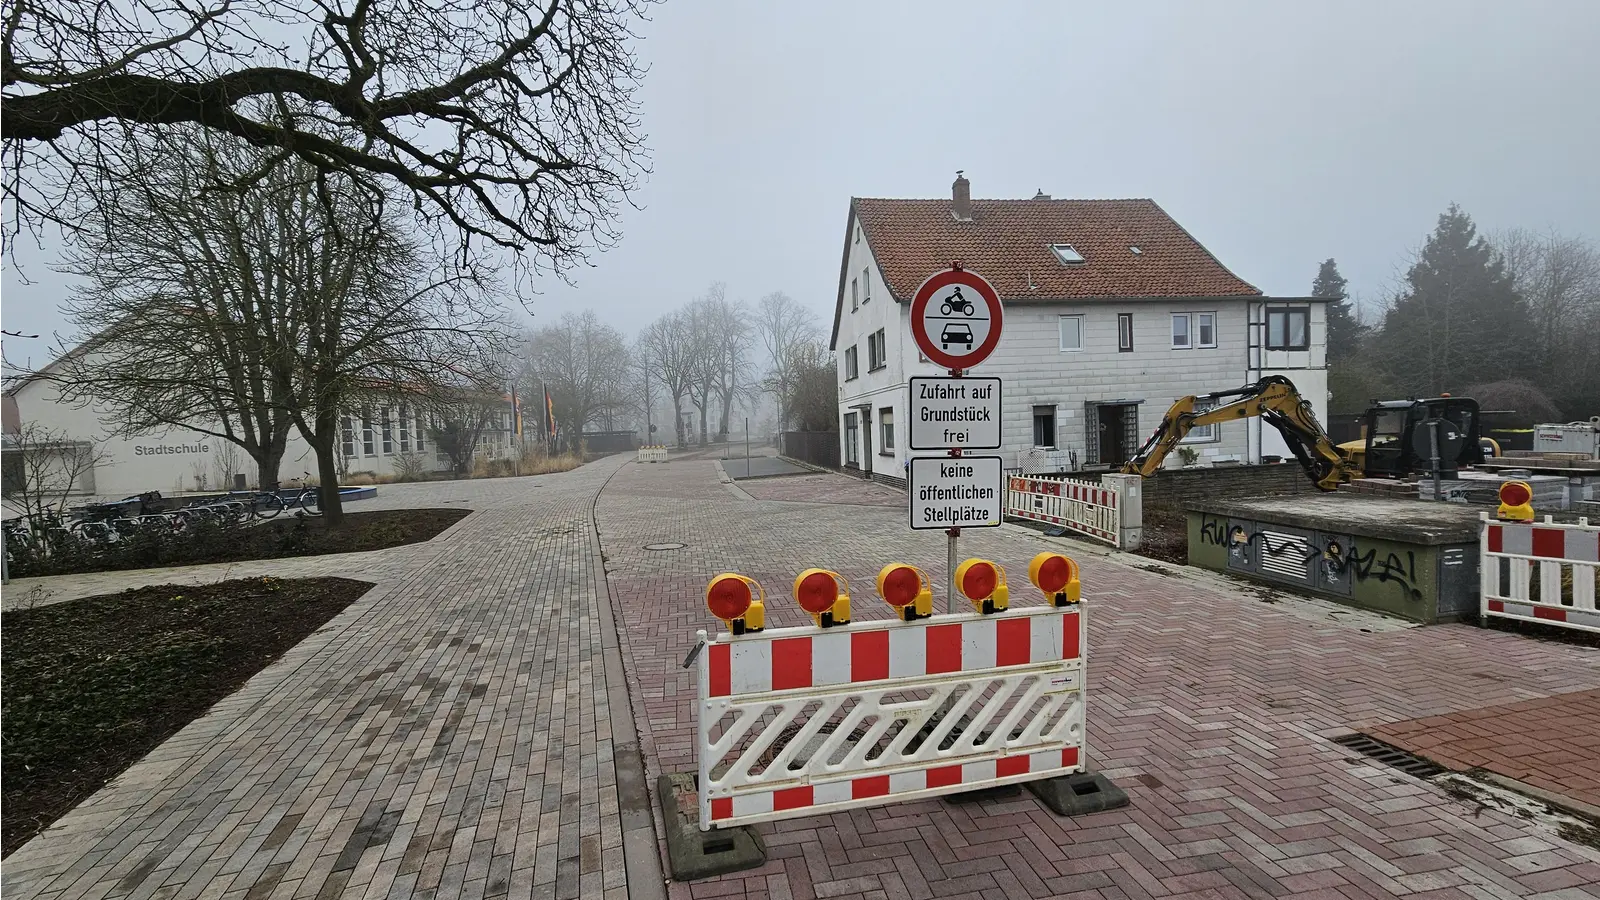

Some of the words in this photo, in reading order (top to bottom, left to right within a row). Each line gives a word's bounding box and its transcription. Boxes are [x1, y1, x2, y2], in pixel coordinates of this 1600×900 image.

[920, 384, 965, 399] Zufahrt
[972, 385, 992, 399] auf
[921, 406, 990, 421] Grundstück
[943, 429, 969, 443] frei
[134, 443, 209, 456] Stadtschule
[940, 463, 973, 477] keine
[920, 485, 993, 501] öffentlichen
[924, 506, 989, 525] Stellplätze
